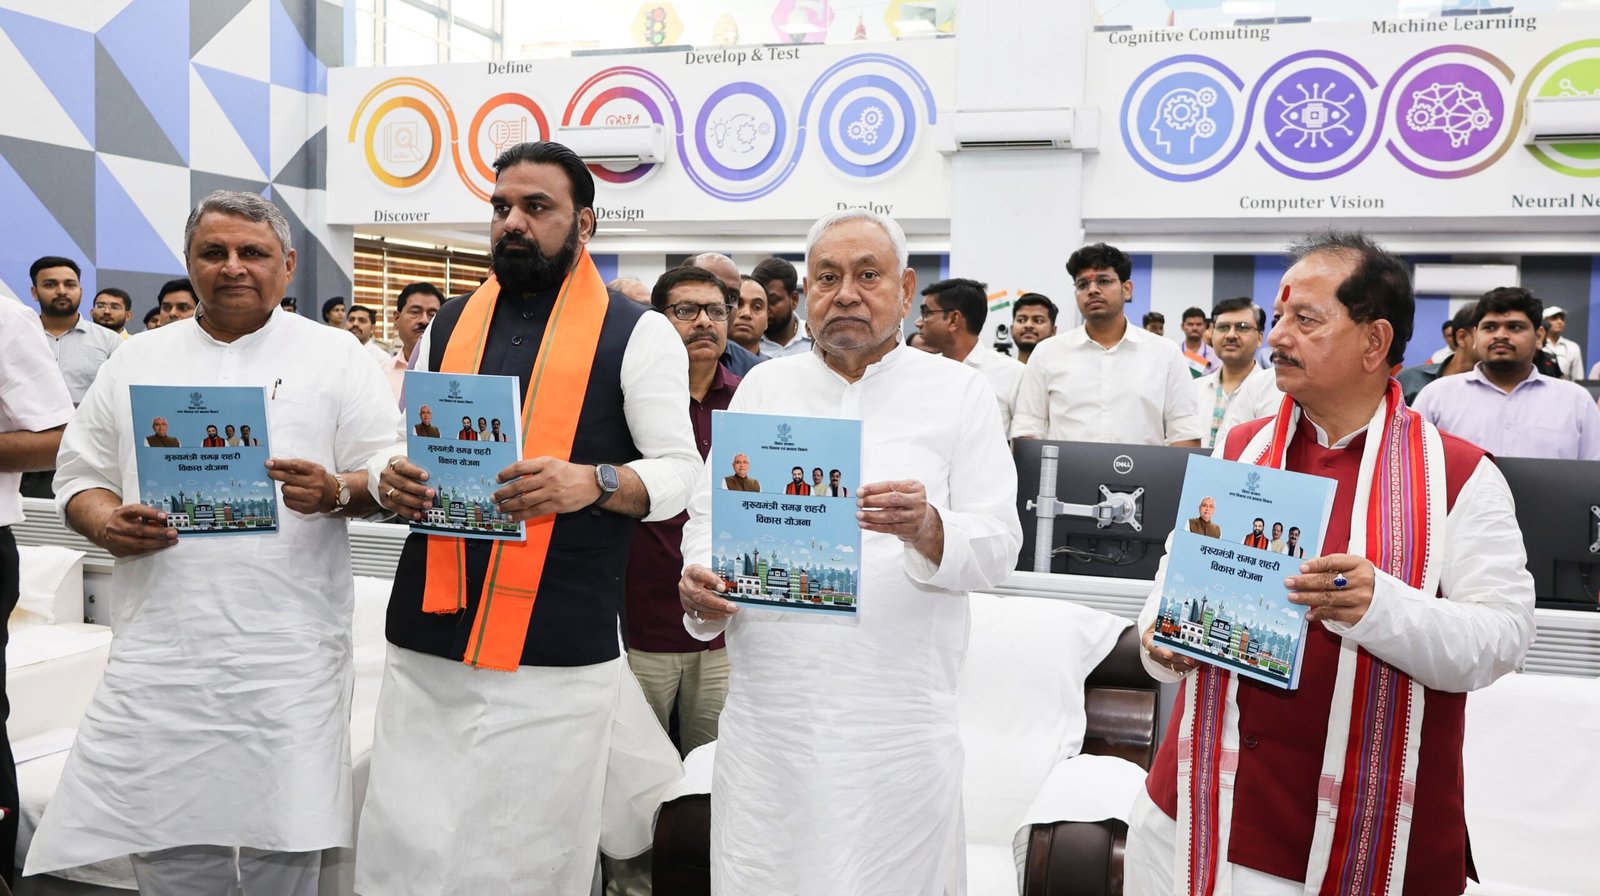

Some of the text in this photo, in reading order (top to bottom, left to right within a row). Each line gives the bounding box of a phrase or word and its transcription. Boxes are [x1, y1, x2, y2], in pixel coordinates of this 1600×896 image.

[1371, 16, 1537, 34] Machine Learning
[1108, 26, 1270, 47] Cognitive Comuting
[685, 46, 800, 66] Develop & Test
[487, 61, 533, 75] Define
[836, 201, 893, 215] Dloy
[1239, 195, 1385, 212] Computer Vision
[1511, 193, 1574, 208] Neural
[374, 209, 430, 222] Discover
[596, 206, 644, 222] Design
[742, 500, 778, 510] मुख्यमंत्री
[804, 504, 826, 513] शहरी
[756, 513, 811, 526] विकास योजना
[1200, 545, 1235, 560] मुख्यमंत्री
[1258, 559, 1280, 571] शहरी
[1210, 560, 1263, 582] विकास योजना
